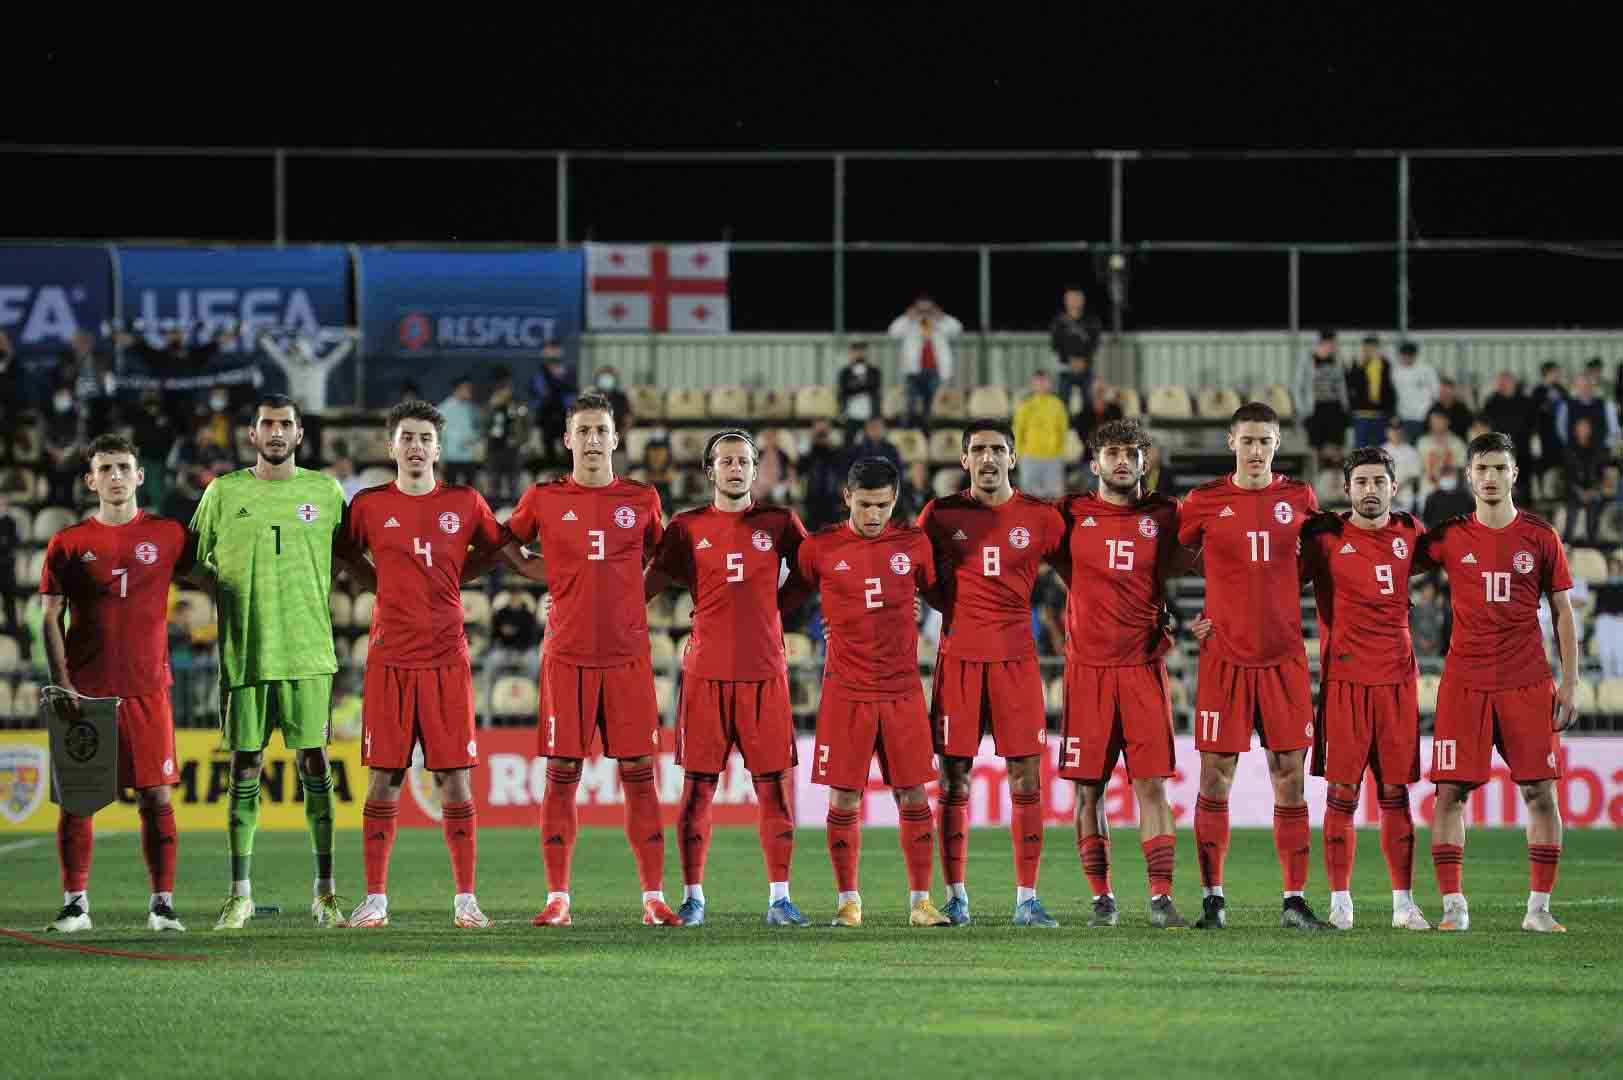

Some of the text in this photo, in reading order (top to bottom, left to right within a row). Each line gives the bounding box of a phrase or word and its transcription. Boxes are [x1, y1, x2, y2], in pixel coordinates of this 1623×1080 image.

[140, 288, 323, 353] UEFA
[436, 316, 556, 347] RESPECT
[271, 525, 281, 555] 1
[413, 537, 433, 568] 4
[587, 530, 605, 561] 3
[1105, 539, 1135, 571] 15
[1246, 531, 1270, 562] 11
[726, 552, 744, 582] 5
[982, 546, 1001, 577] 8
[111, 568, 129, 598] 7
[865, 577, 884, 609] 2
[1375, 564, 1394, 595] 9
[1481, 571, 1512, 602] 10
[1199, 710, 1220, 742] 11
[818, 745, 830, 776] 2
[1435, 739, 1457, 770] 10
